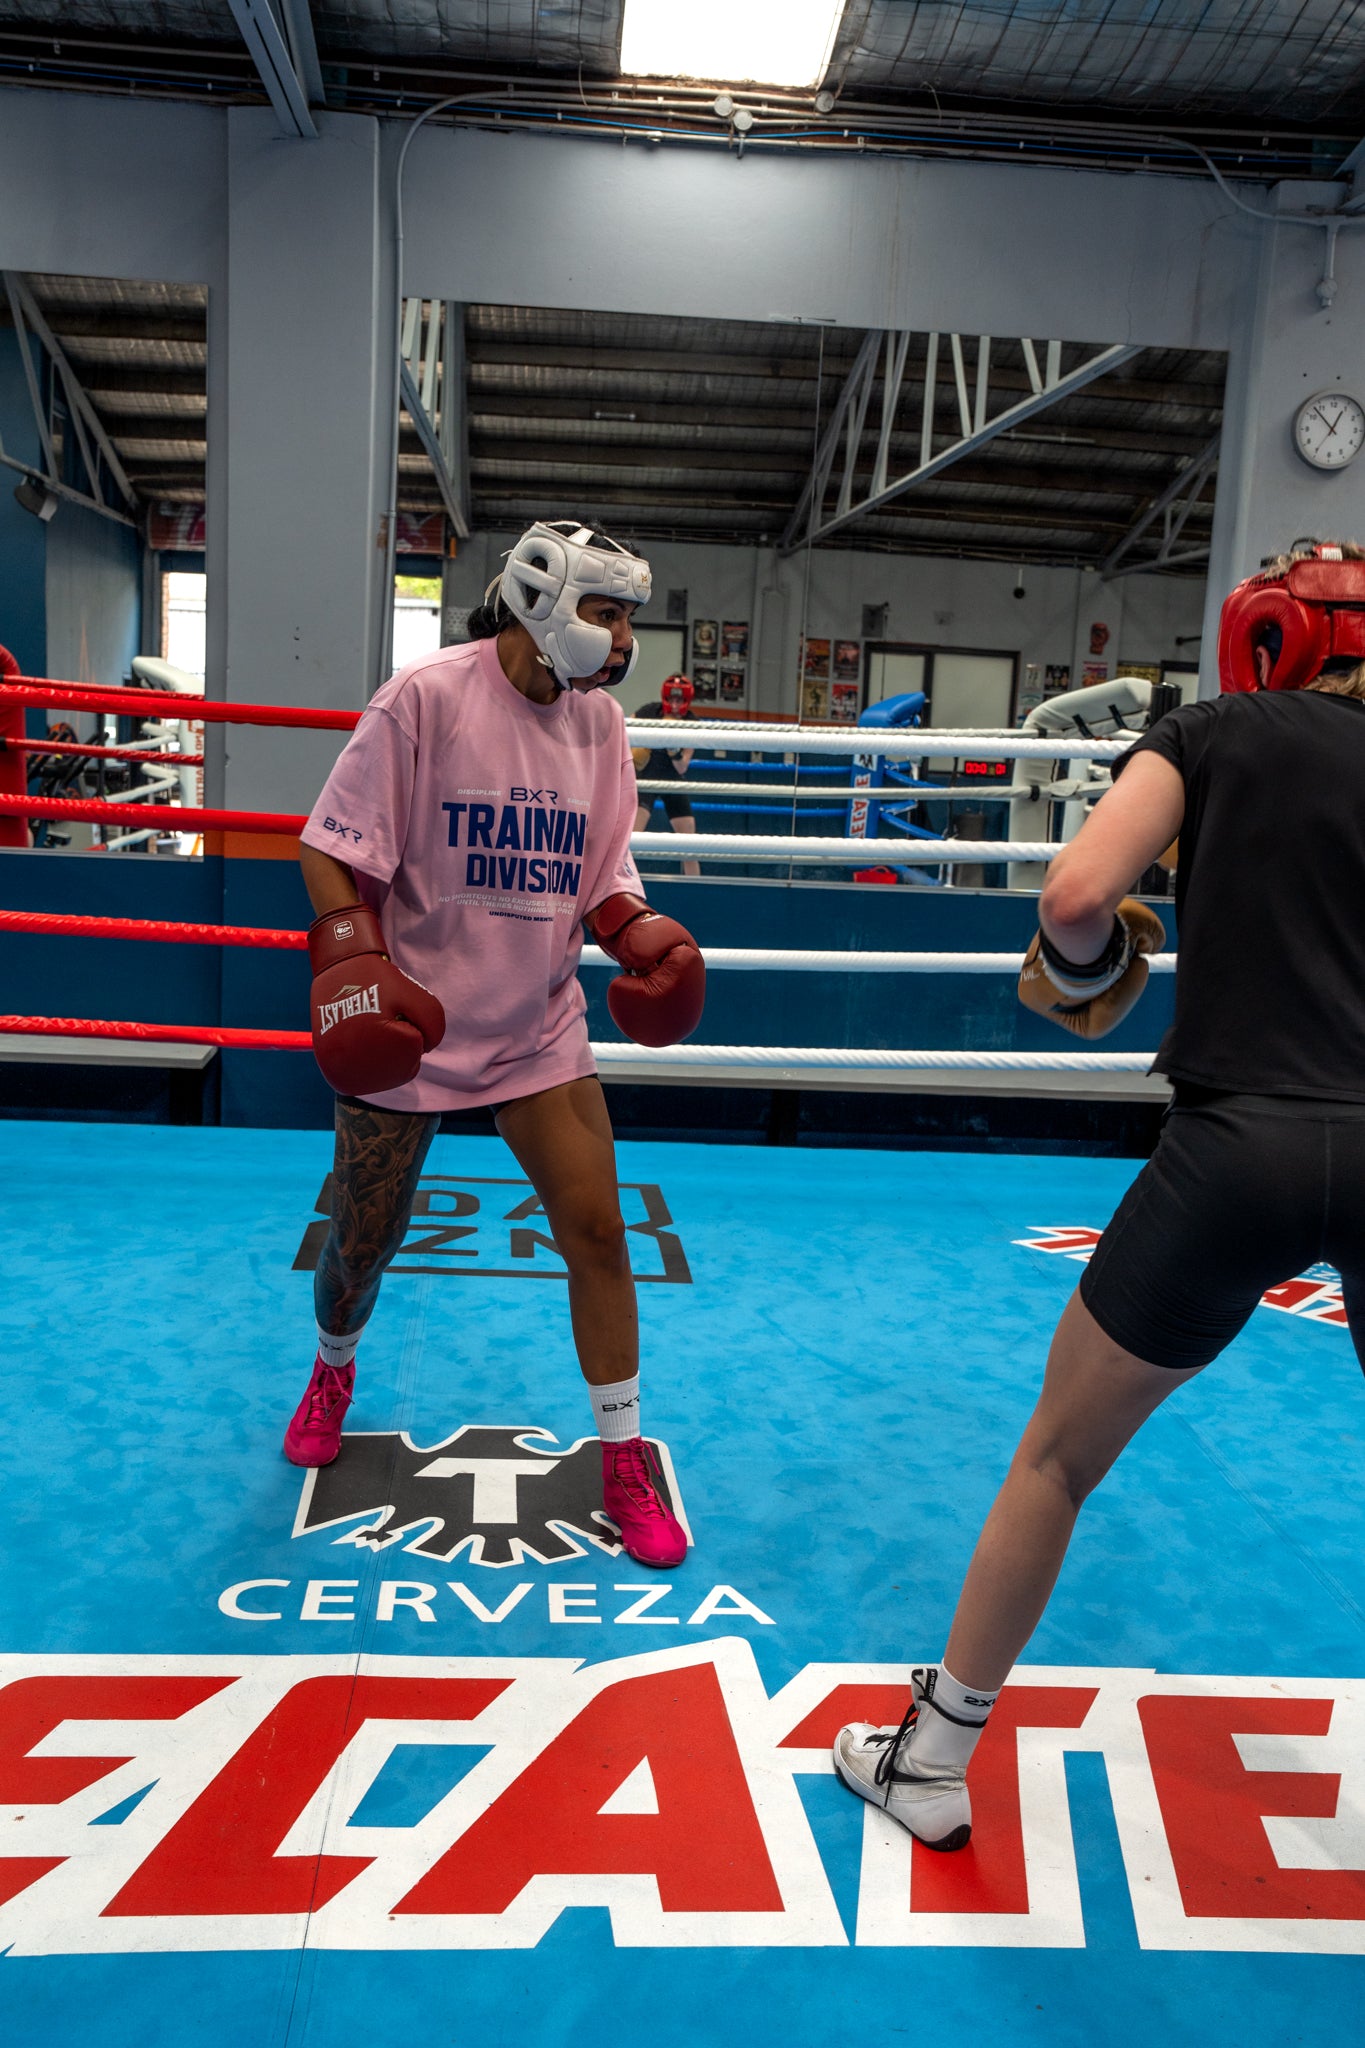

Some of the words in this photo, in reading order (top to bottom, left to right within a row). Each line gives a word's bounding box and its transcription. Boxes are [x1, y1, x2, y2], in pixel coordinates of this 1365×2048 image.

[510, 787, 558, 805] BXR
[323, 816, 362, 844] BXR
[442, 802, 588, 857] TRAININ
[466, 854, 581, 897] DIVISION
[319, 984, 382, 1036] EVERLAST
[217, 1578, 777, 1625] CERVEZA
